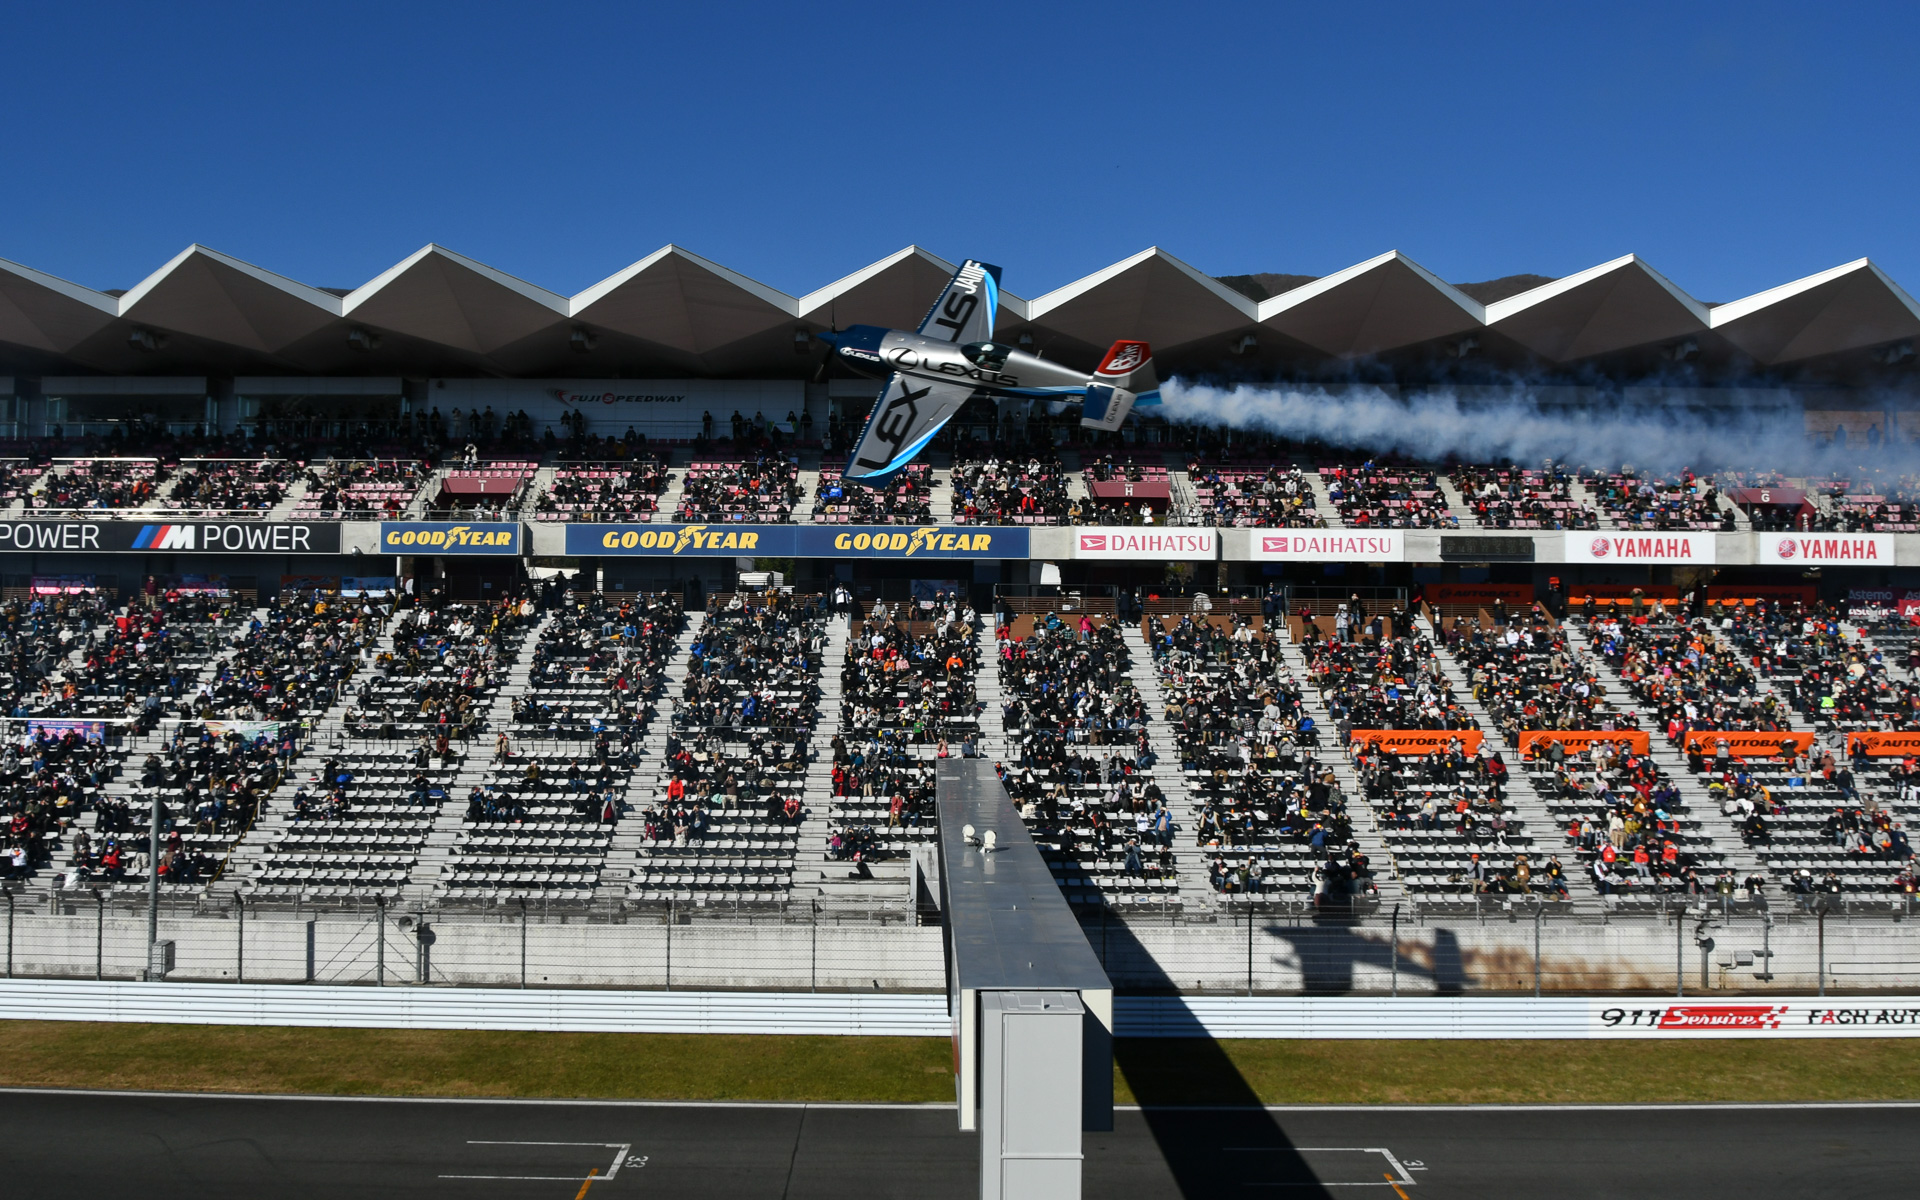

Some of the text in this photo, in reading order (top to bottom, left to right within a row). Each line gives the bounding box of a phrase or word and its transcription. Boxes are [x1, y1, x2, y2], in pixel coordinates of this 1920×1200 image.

[923, 357, 1019, 388] LEXUS
[856, 379, 932, 470] LEX
[1125, 487, 1133, 496] H
[1761, 493, 1770, 503] G
[0, 524, 100, 549] POWER
[203, 525, 311, 550] POWER
[1112, 535, 1212, 551] DAIHATSU
[1294, 537, 1391, 553] DAIHATSU
[1613, 538, 1692, 558] YAMAHA
[1800, 539, 1878, 559] YAMAHA
[1848, 589, 1893, 600] Astemo
[1385, 738, 1467, 746] AUTOBAS
[1600, 1008, 1756, 1027] 911 Service
[1808, 1009, 1920, 1024] FACH AUT
